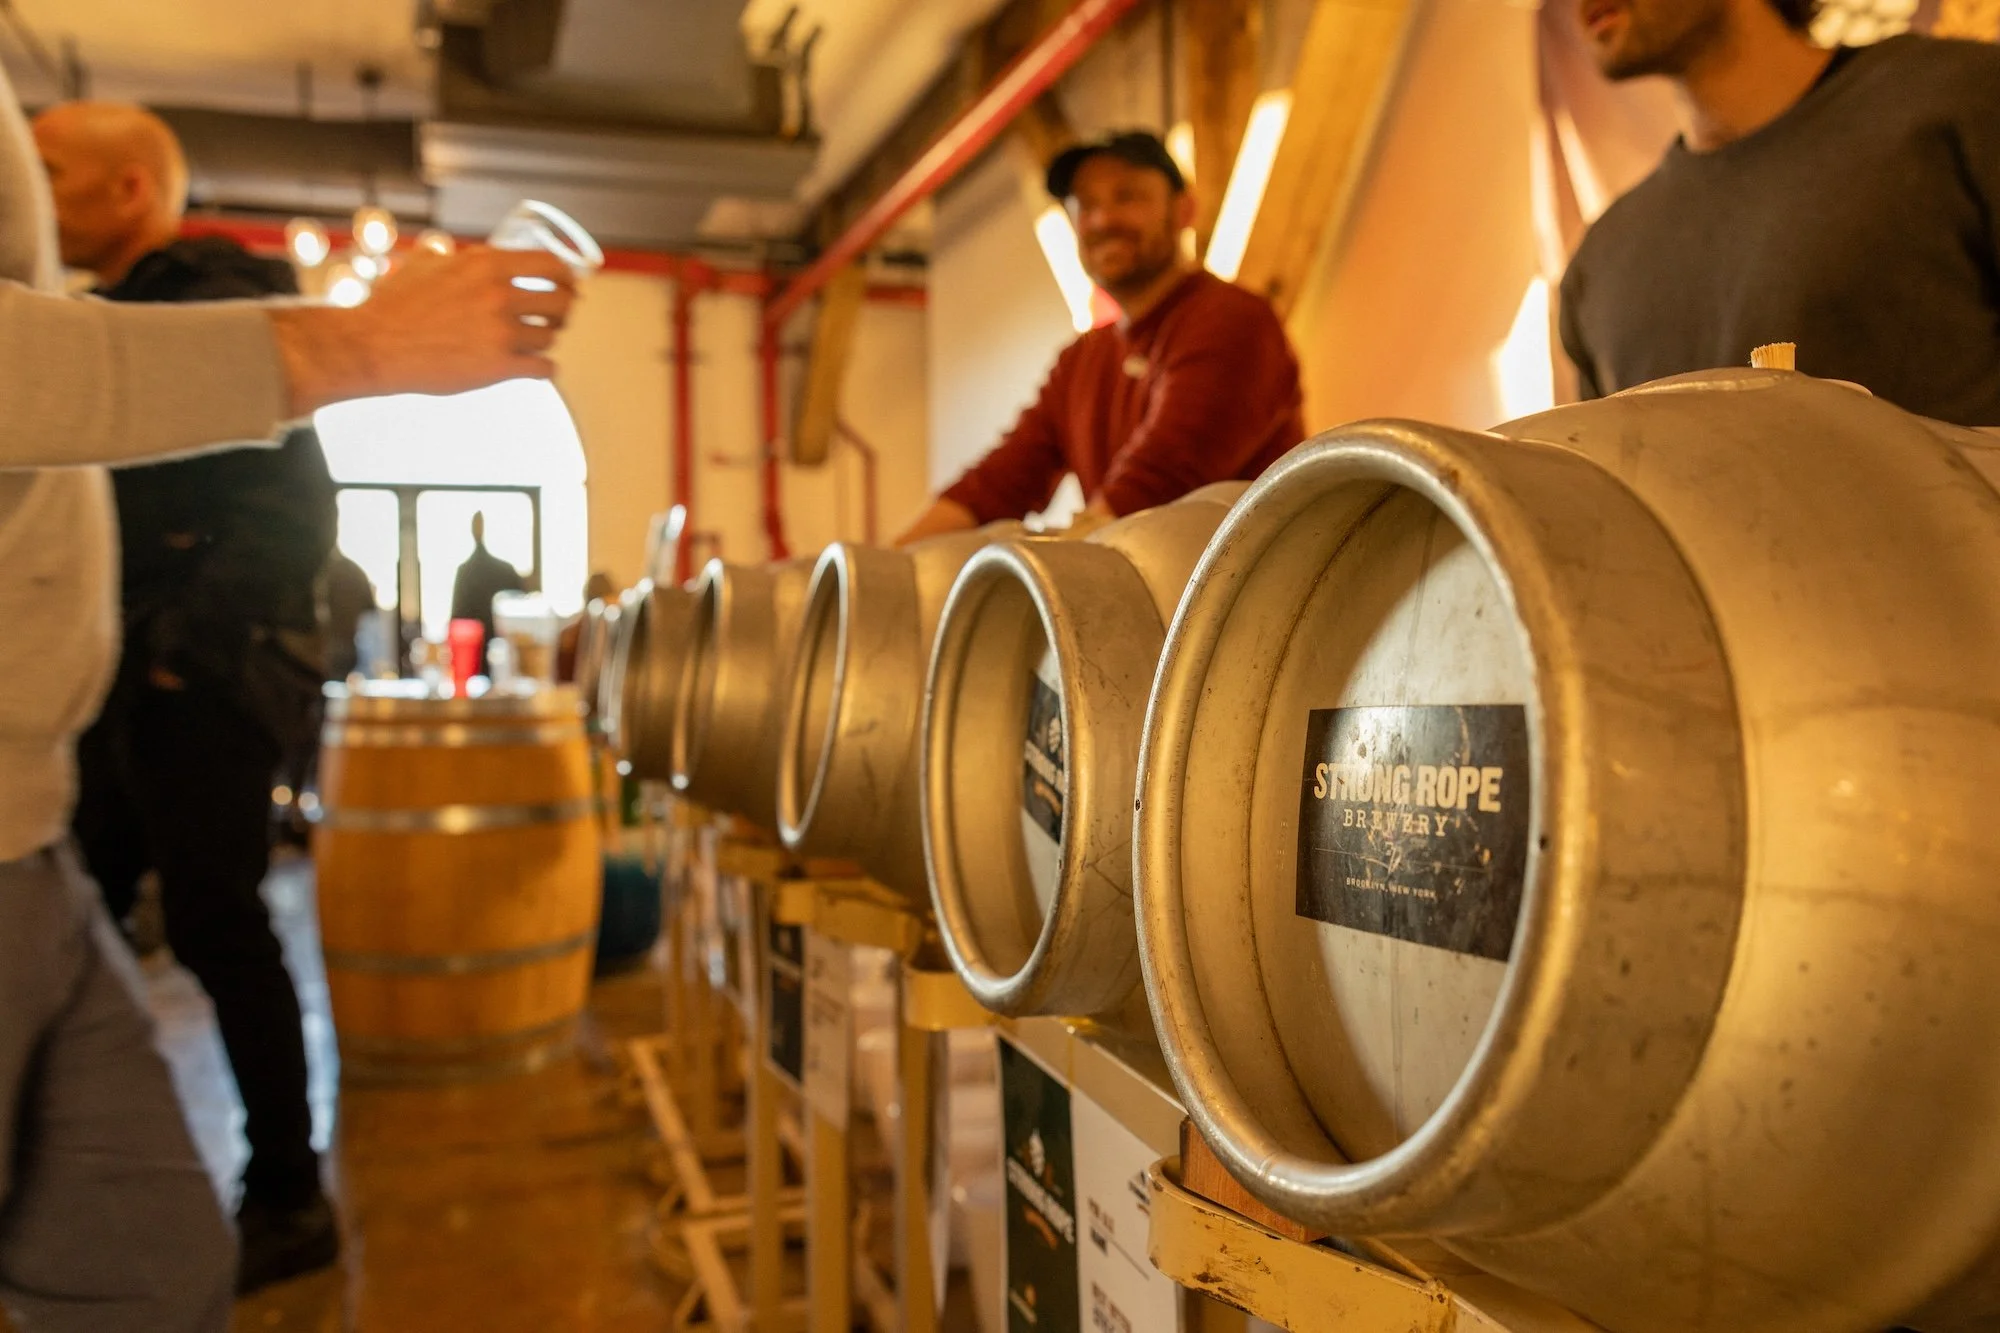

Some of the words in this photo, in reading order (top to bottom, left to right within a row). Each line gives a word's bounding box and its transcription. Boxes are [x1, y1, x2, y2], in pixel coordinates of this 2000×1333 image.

[1313, 762, 1411, 805] STRONG
[1416, 765, 1504, 812] ROPE
[1342, 809, 1449, 837] BREWERY
